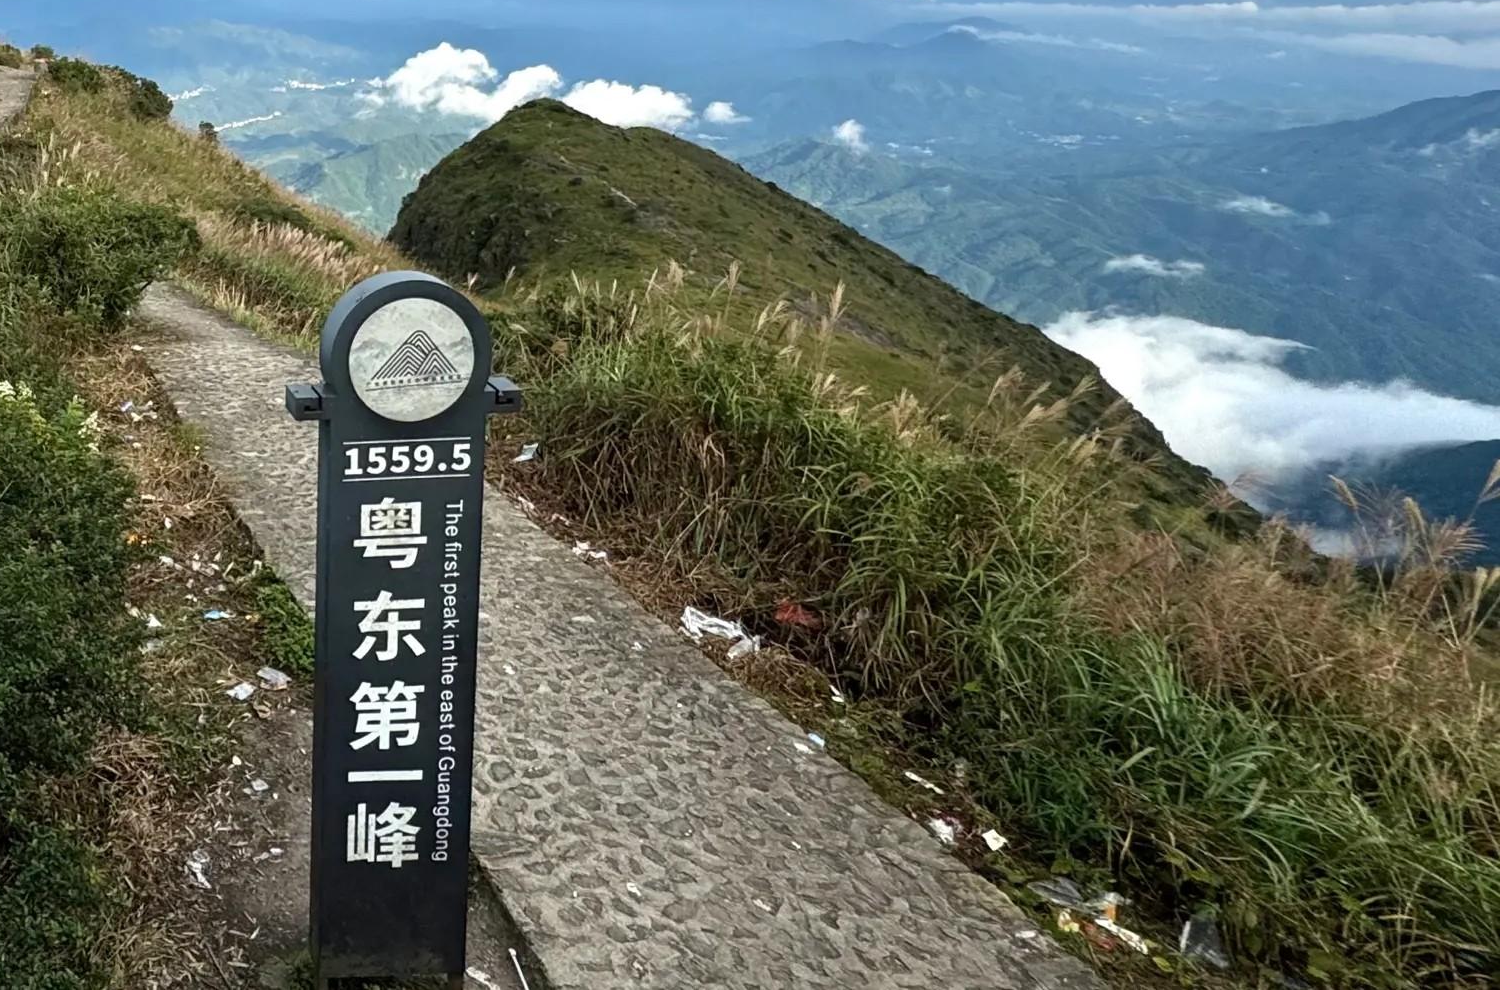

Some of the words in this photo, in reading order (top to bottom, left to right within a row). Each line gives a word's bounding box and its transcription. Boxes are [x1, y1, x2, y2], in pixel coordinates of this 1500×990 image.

[344, 443, 471, 475] 1559.5
[444, 499, 464, 537] The
[443, 542, 463, 578] first
[439, 583, 460, 629] peak
[441, 634, 460, 651] in
[346, 496, 428, 868] 粤东第一峰
[440, 655, 459, 685] the
[438, 690, 456, 730] east
[438, 734, 456, 752] of
[431, 756, 456, 862] Guangdong
